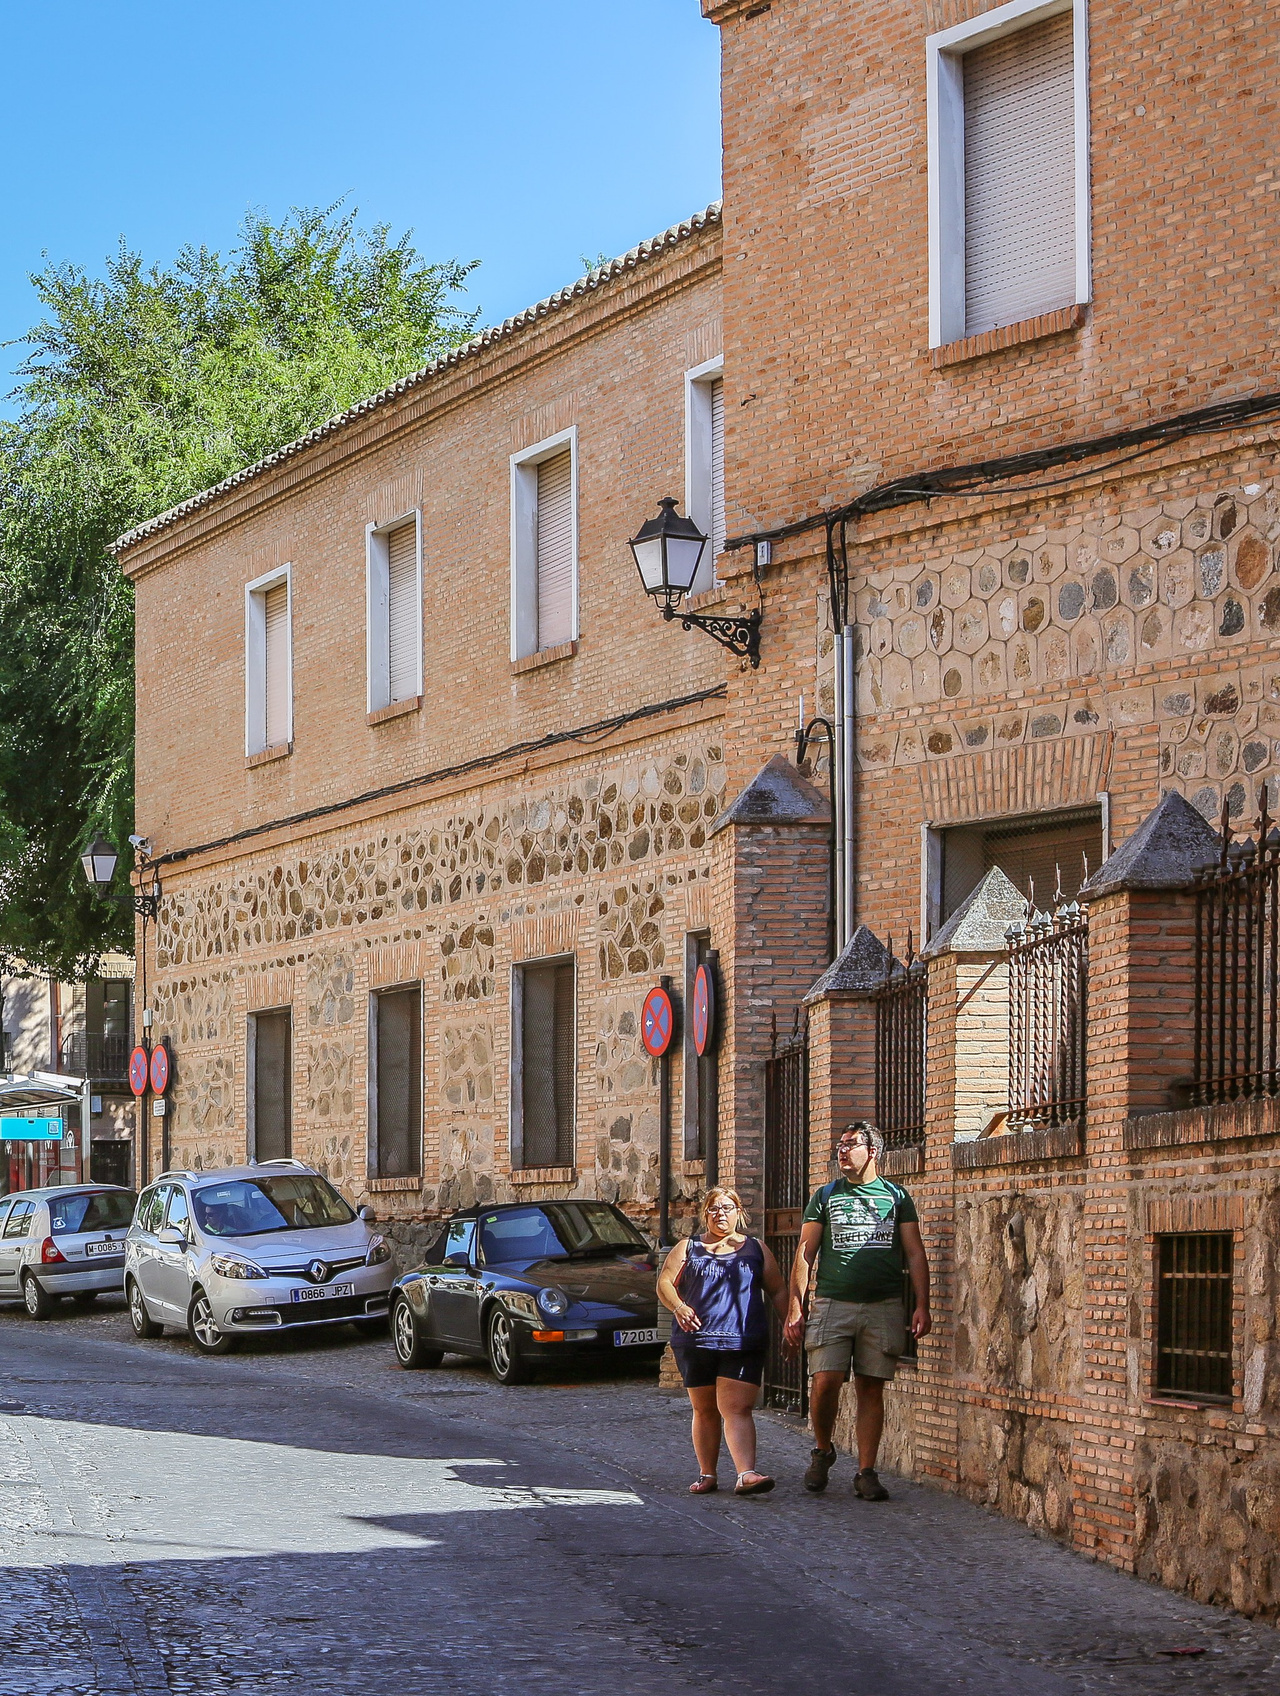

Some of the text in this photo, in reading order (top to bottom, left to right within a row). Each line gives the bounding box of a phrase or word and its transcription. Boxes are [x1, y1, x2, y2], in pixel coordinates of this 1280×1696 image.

[834, 1230, 893, 1243] REVELSTOKE
[301, 1285, 349, 1300] 0866 JPZ
[622, 1330, 653, 1344] 7203
